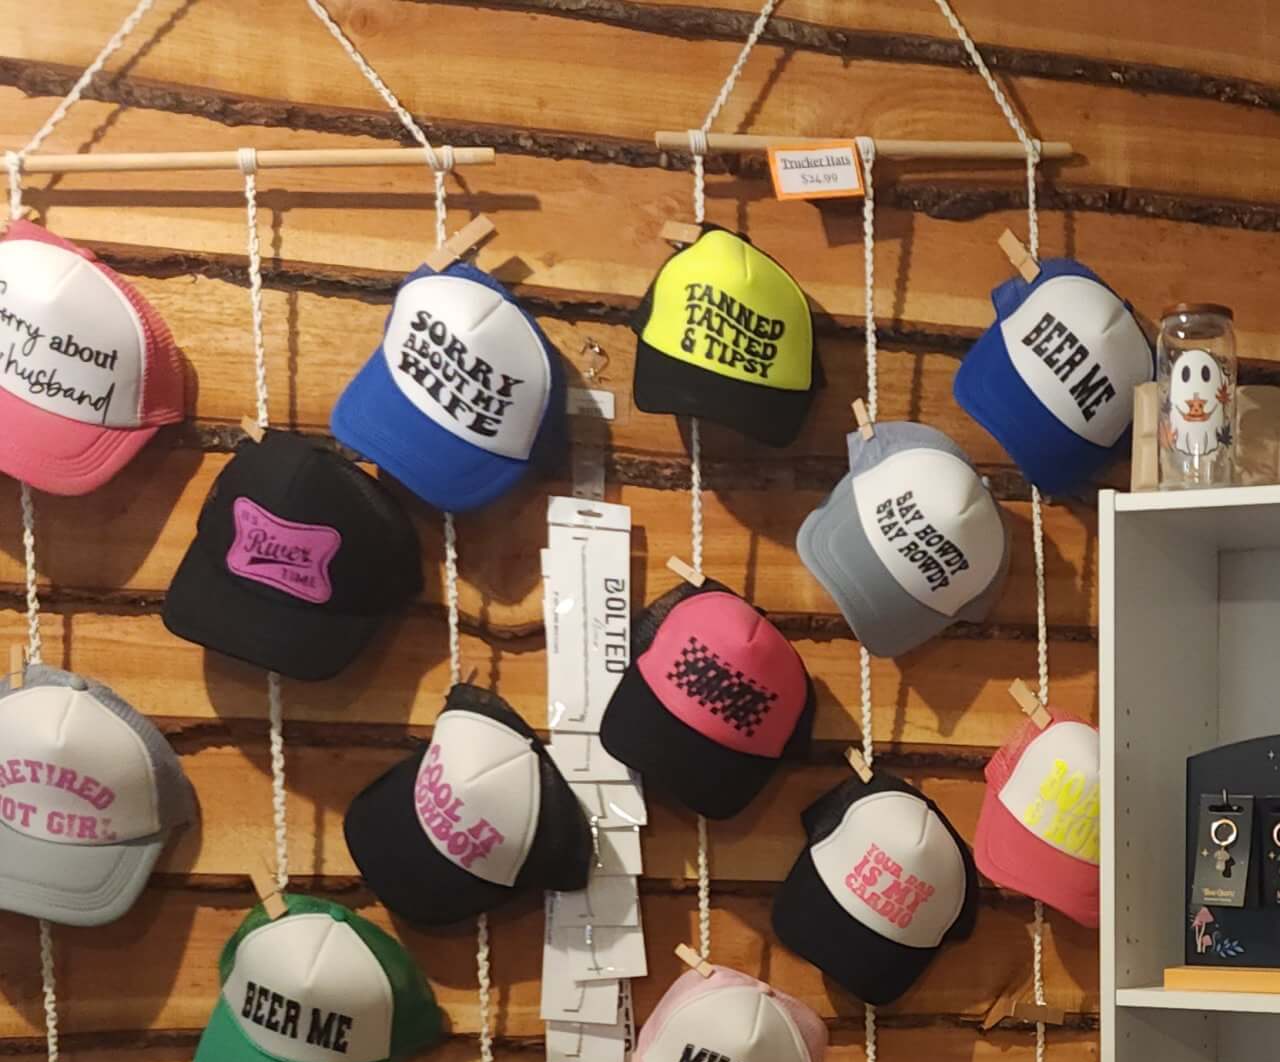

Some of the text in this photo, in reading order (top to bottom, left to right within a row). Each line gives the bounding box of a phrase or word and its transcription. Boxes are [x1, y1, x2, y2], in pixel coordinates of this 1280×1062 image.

[781, 155, 851, 170] Trucker Hats
[684, 283, 785, 342] TANNED
[685, 303, 777, 361] TATTED
[49, 334, 118, 371] about
[402, 332, 515, 416] ABOUT MY
[409, 310, 525, 398] SORRY
[680, 327, 774, 379] & TIPSY
[1021, 312, 1116, 422] BEER ME
[5, 342, 116, 425] husband
[398, 350, 503, 438] WIFE
[896, 491, 925, 525] SAY
[244, 528, 313, 564] River
[876, 498, 950, 592] STAY ROWDY
[604, 578, 627, 675] BOLTED
[0, 795, 117, 840] OT GIRL
[465, 817, 503, 853] IT
[851, 854, 882, 888] IS
[846, 876, 911, 927] CARDIO
[242, 981, 353, 1054] BEER ME
